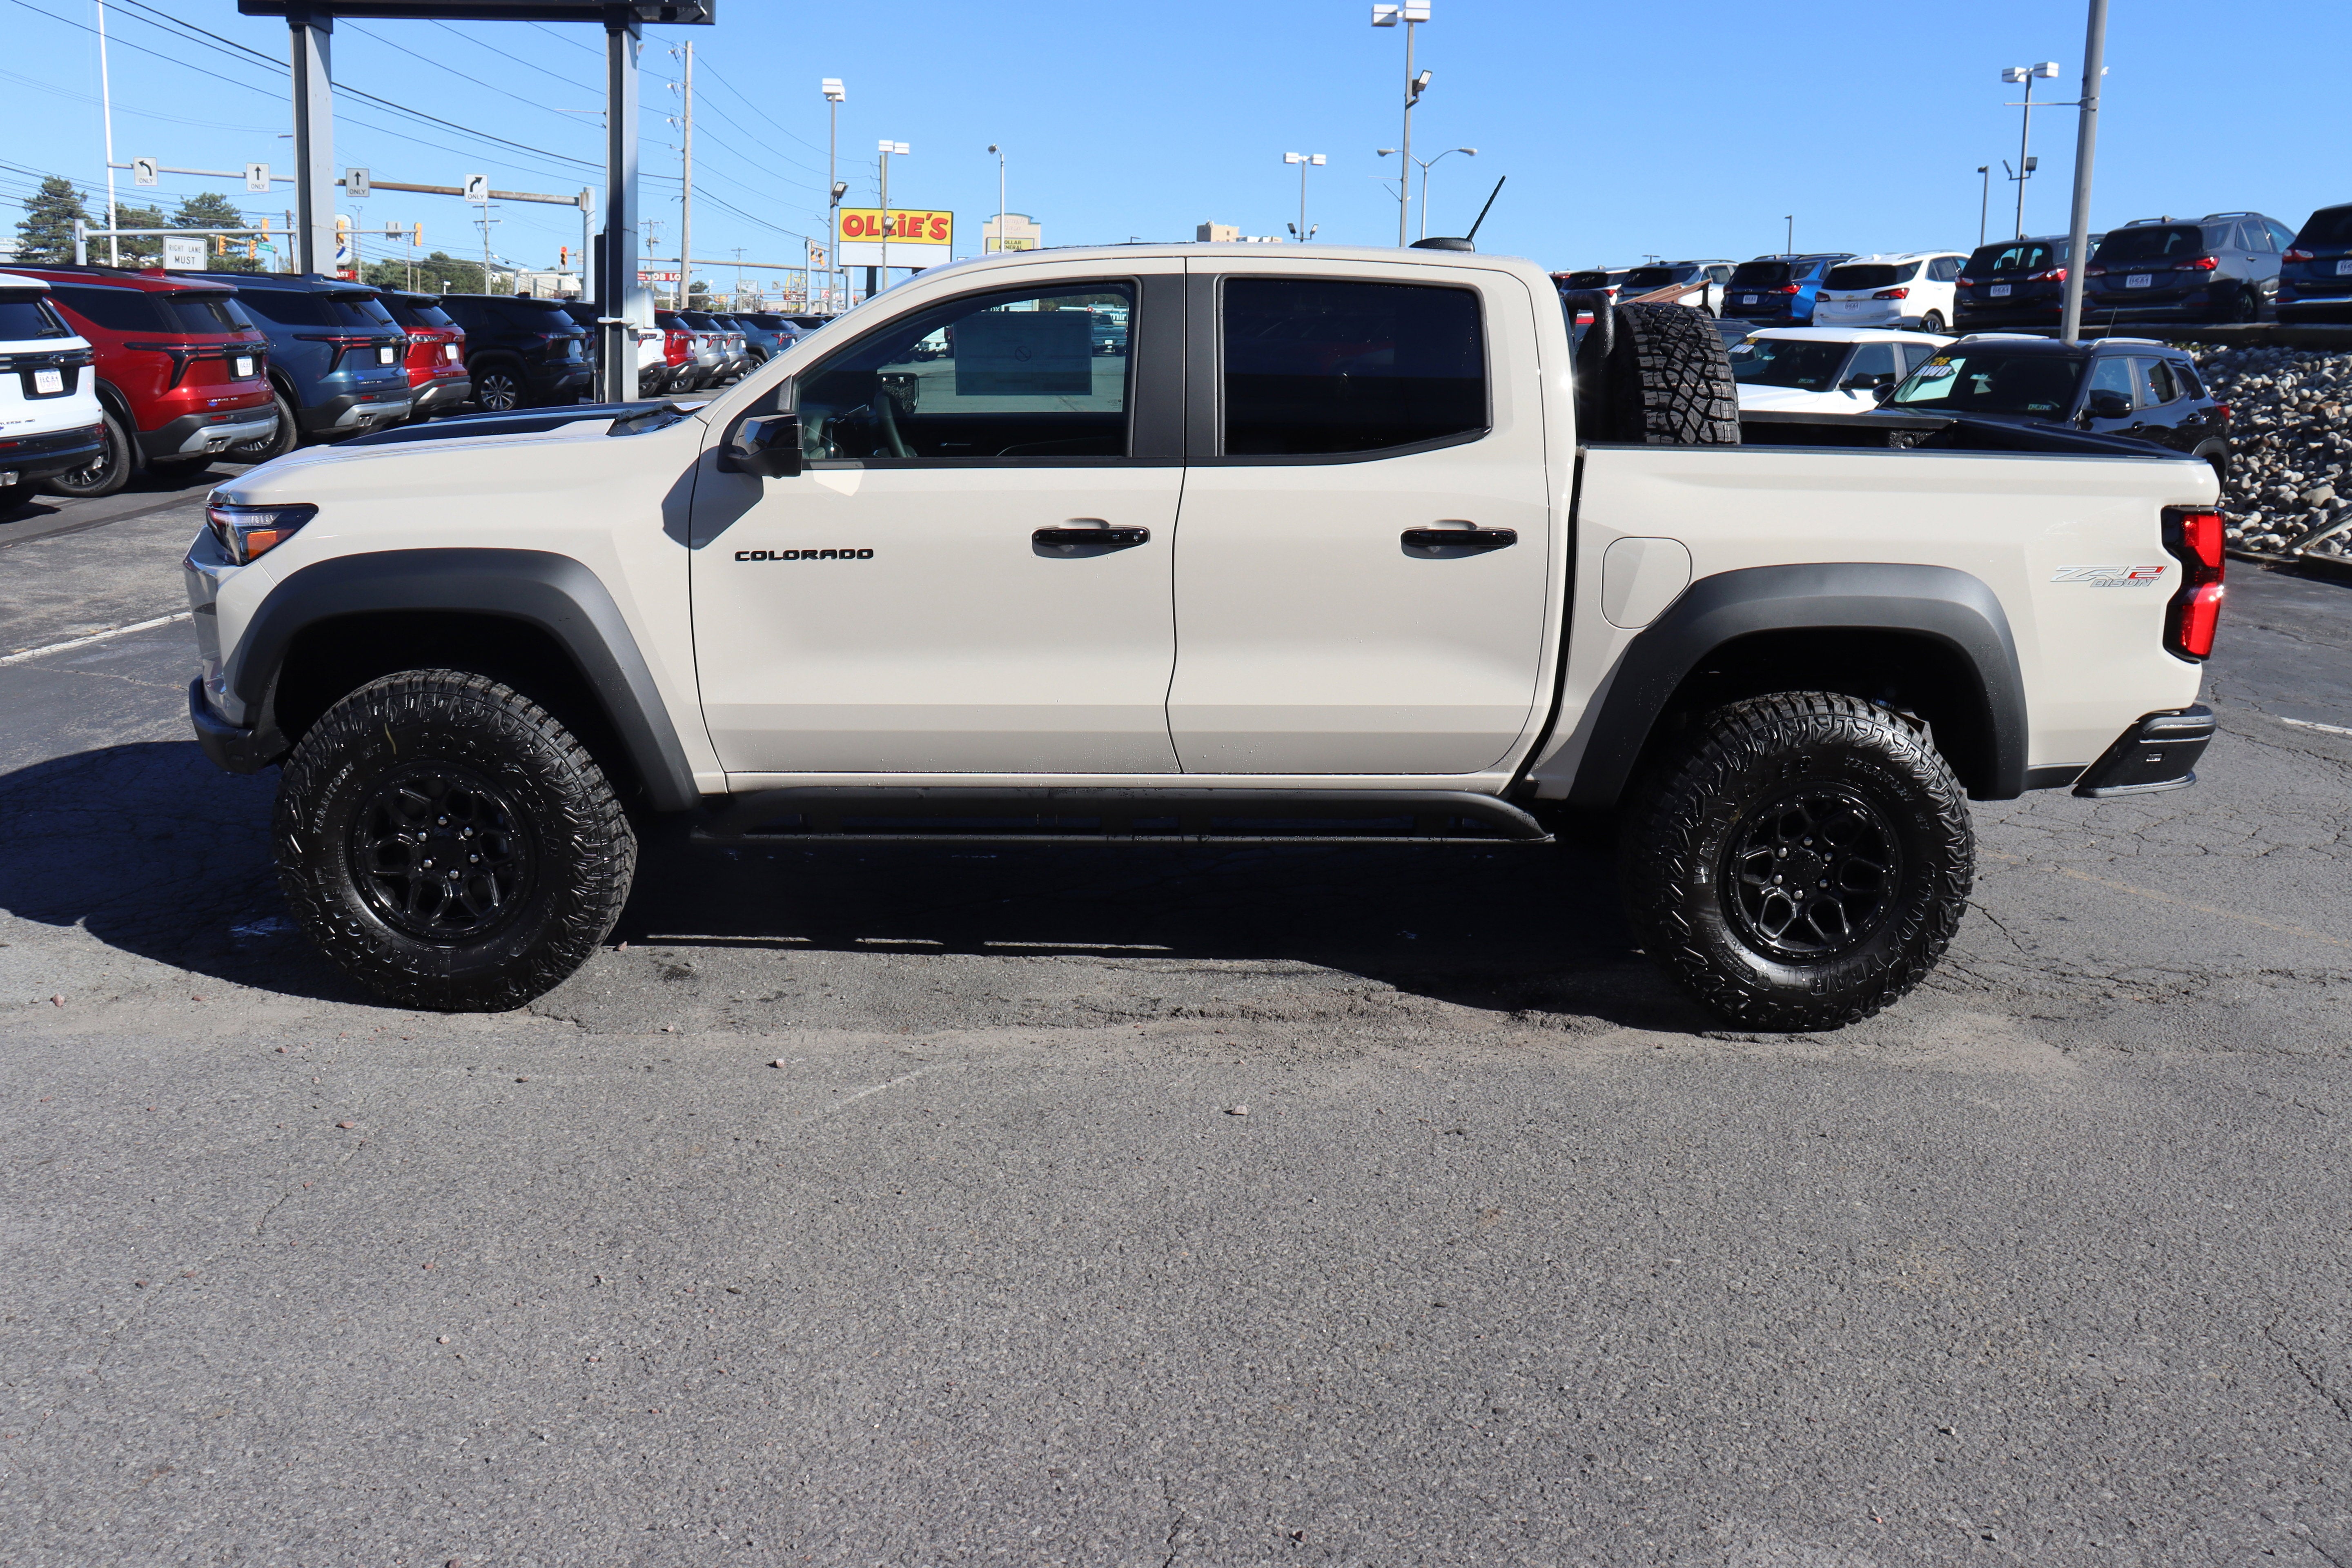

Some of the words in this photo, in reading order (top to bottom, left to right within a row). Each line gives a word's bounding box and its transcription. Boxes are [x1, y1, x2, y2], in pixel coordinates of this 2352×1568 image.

[175, 256, 195, 265] MUST
[1930, 356, 1951, 366] 26
[1913, 365, 1952, 377] AWD
[734, 548, 874, 561] COLORADO
[2050, 565, 2168, 582] ZR2
[2089, 578, 2156, 588] BISON
[312, 761, 354, 834] TERRITORY
